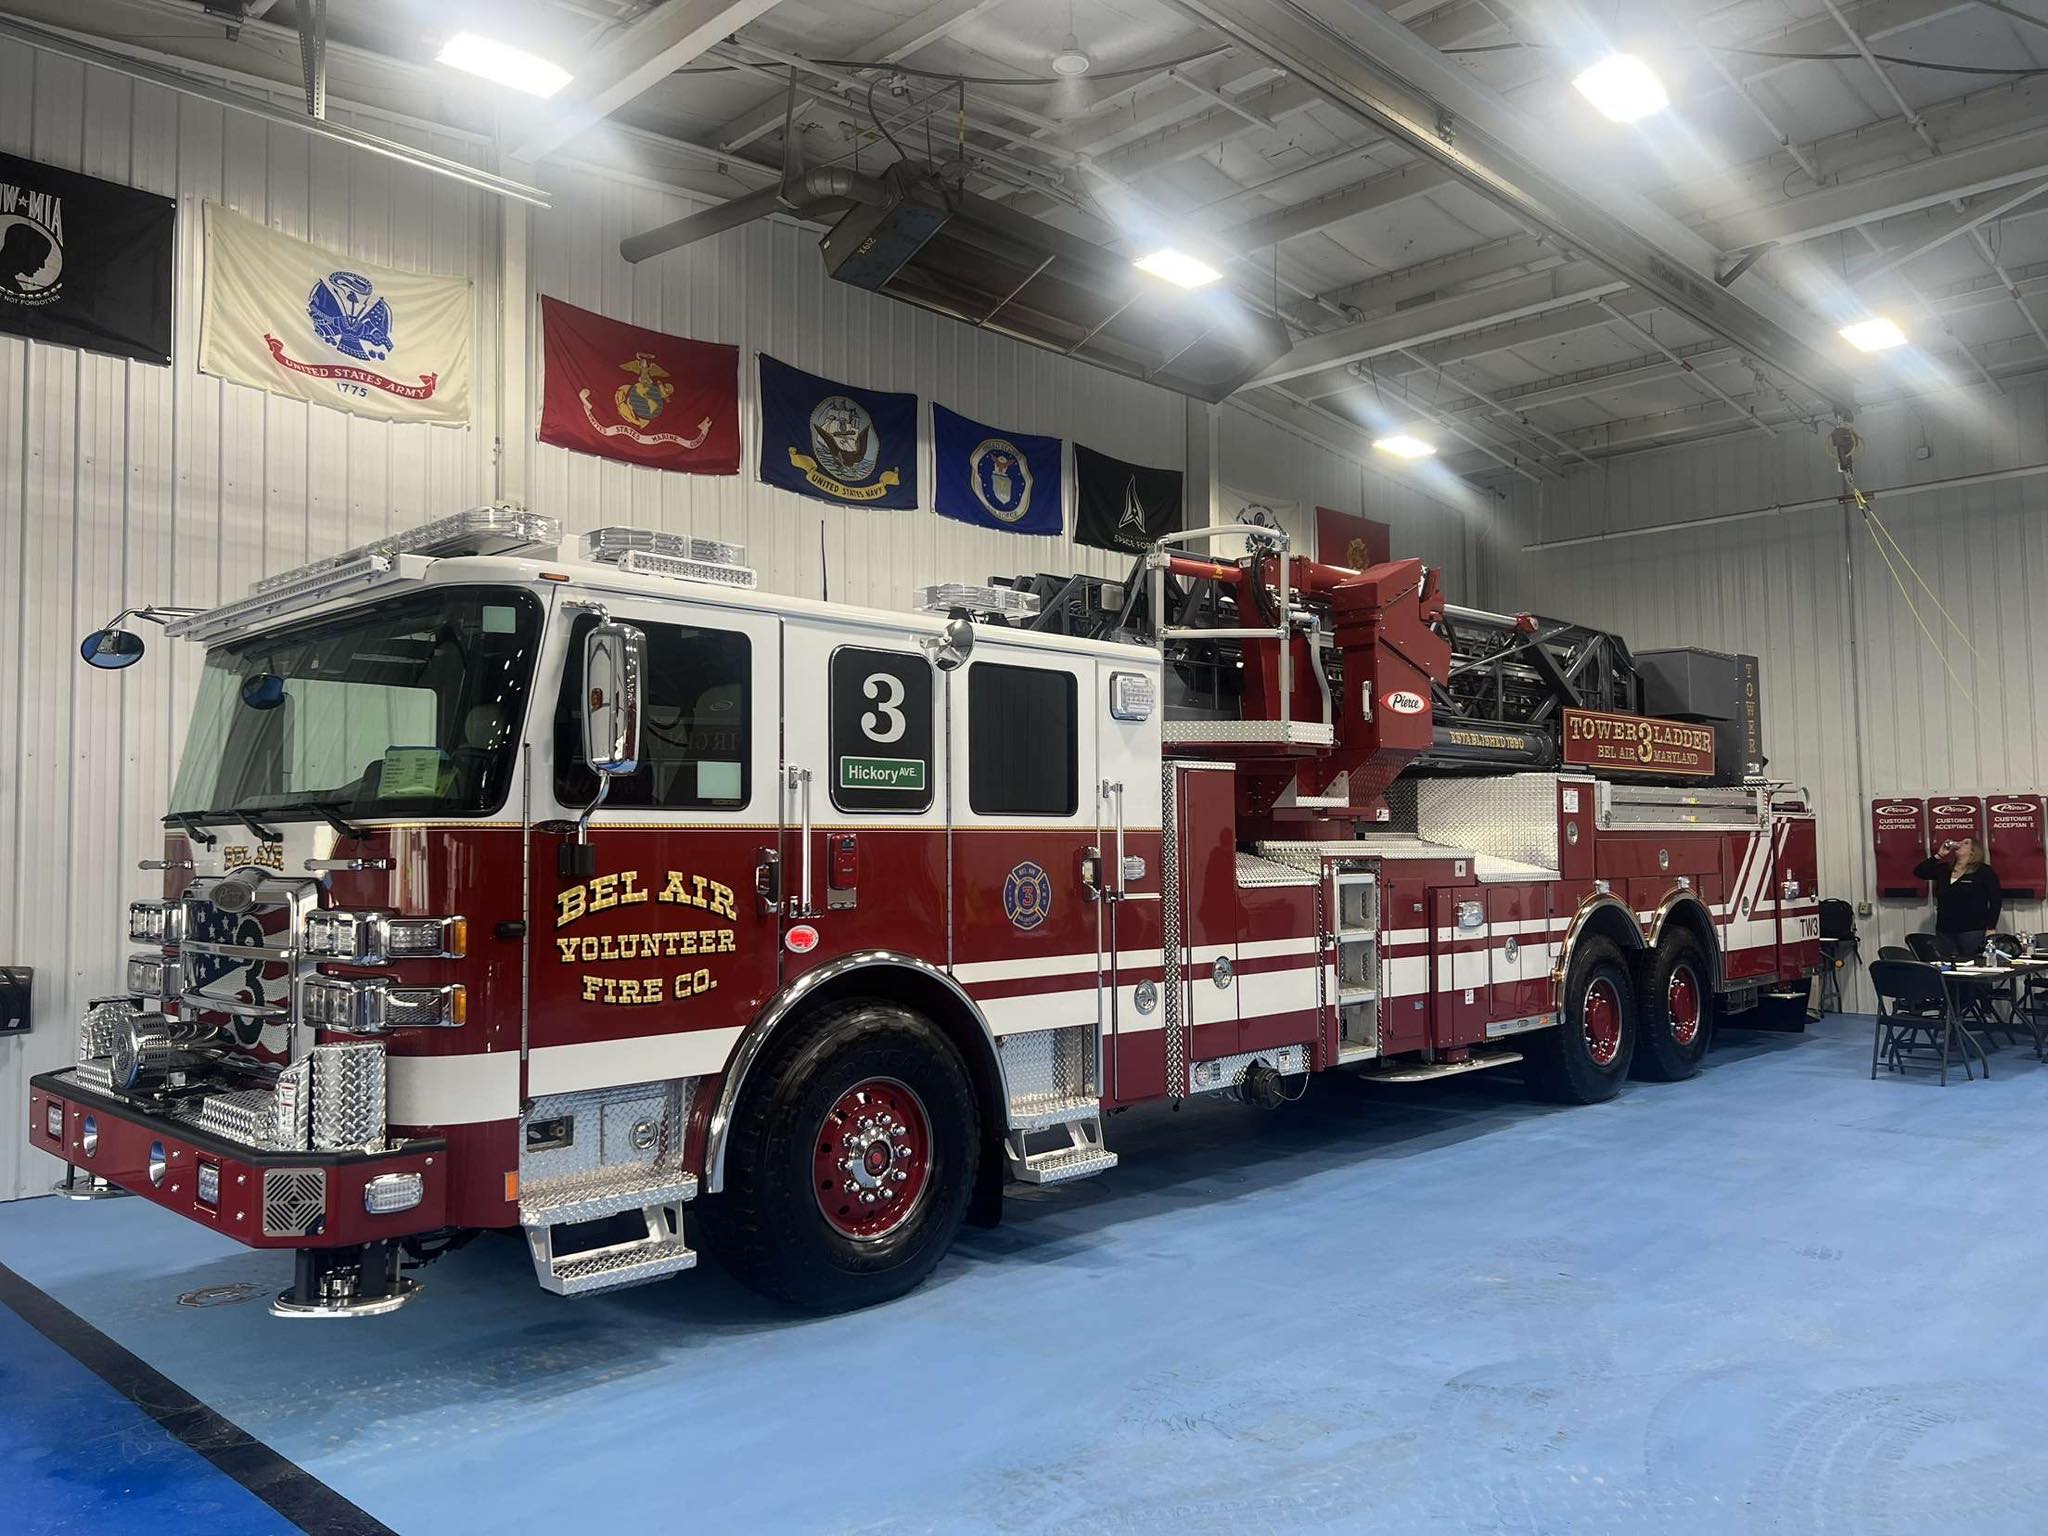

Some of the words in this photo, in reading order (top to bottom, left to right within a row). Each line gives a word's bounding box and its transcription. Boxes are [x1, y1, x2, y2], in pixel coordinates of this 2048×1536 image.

[29, 191, 63, 247] MIA
[4, 295, 19, 304] NOT
[20, 295, 60, 306] FORGOTTEN
[285, 359, 329, 377] UNITED
[334, 368, 383, 386] STATES
[386, 384, 426, 398] ARMY
[336, 383, 368, 397] 1775
[811, 474, 840, 493] UNITED
[842, 488, 865, 498] STATES
[865, 486, 883, 498] NAVY
[860, 673, 906, 743] 3
[1392, 693, 1420, 709] Pierce
[1745, 663, 1757, 753] TOWER
[1570, 716, 1637, 741] TOWER
[1637, 722, 1653, 763] 3
[1653, 725, 1711, 754] LADDER
[1597, 745, 1617, 758] BEL
[1653, 750, 1698, 765] MARYLAND
[849, 765, 898, 784] Hickory
[224, 846, 252, 871] BEL
[254, 845, 284, 872] AIR
[557, 871, 649, 928] BEL
[658, 871, 737, 922] AIR
[1022, 886, 1033, 907] 3
[1800, 917, 1818, 938] TW3
[557, 929, 736, 962] VOLUNTEER
[583, 975, 663, 1004] FIRE
[675, 968, 718, 998] CO.
